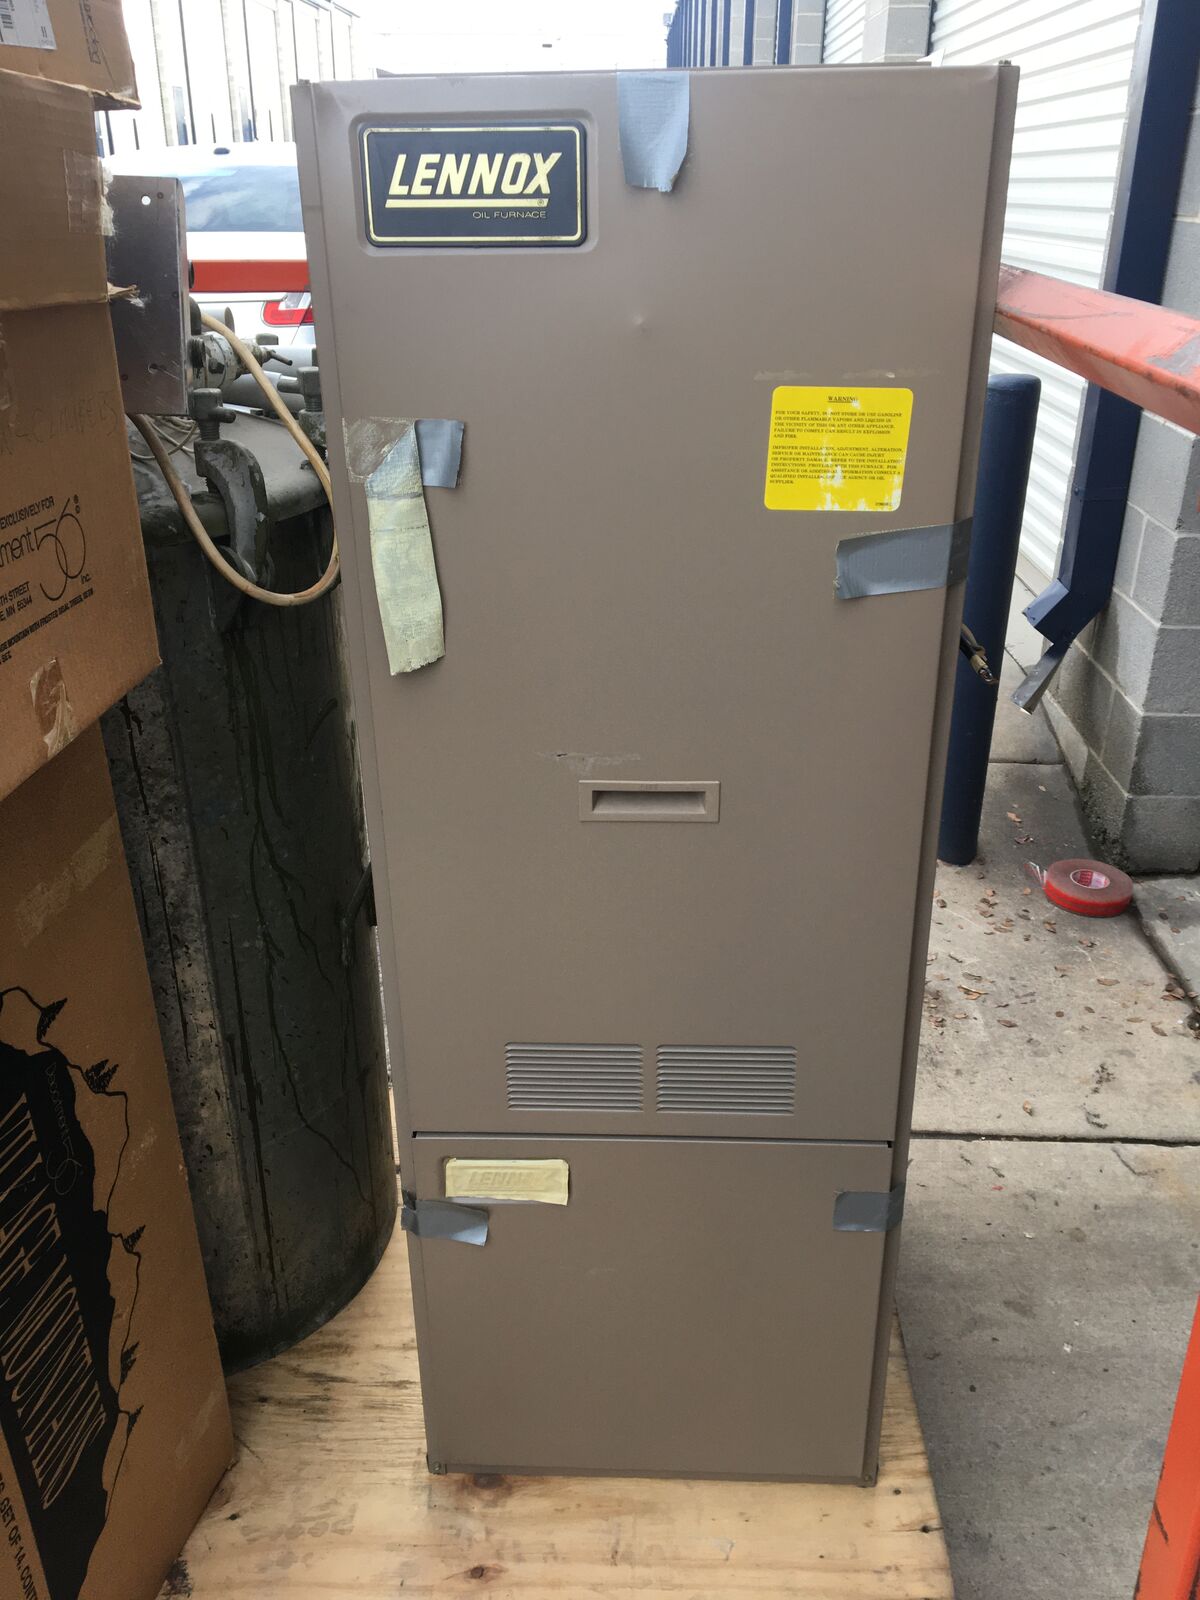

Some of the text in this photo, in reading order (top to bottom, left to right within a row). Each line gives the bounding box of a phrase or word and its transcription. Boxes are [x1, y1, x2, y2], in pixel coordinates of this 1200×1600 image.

[388, 152, 562, 195] LENNOX
[472, 211, 546, 219] OIL FURNACE
[1, 496, 55, 530] EXCLUSIVELY FOR
[0, 527, 35, 567] ment
[8, 581, 30, 601] STREET
[8, 1525, 21, 1547] OF
